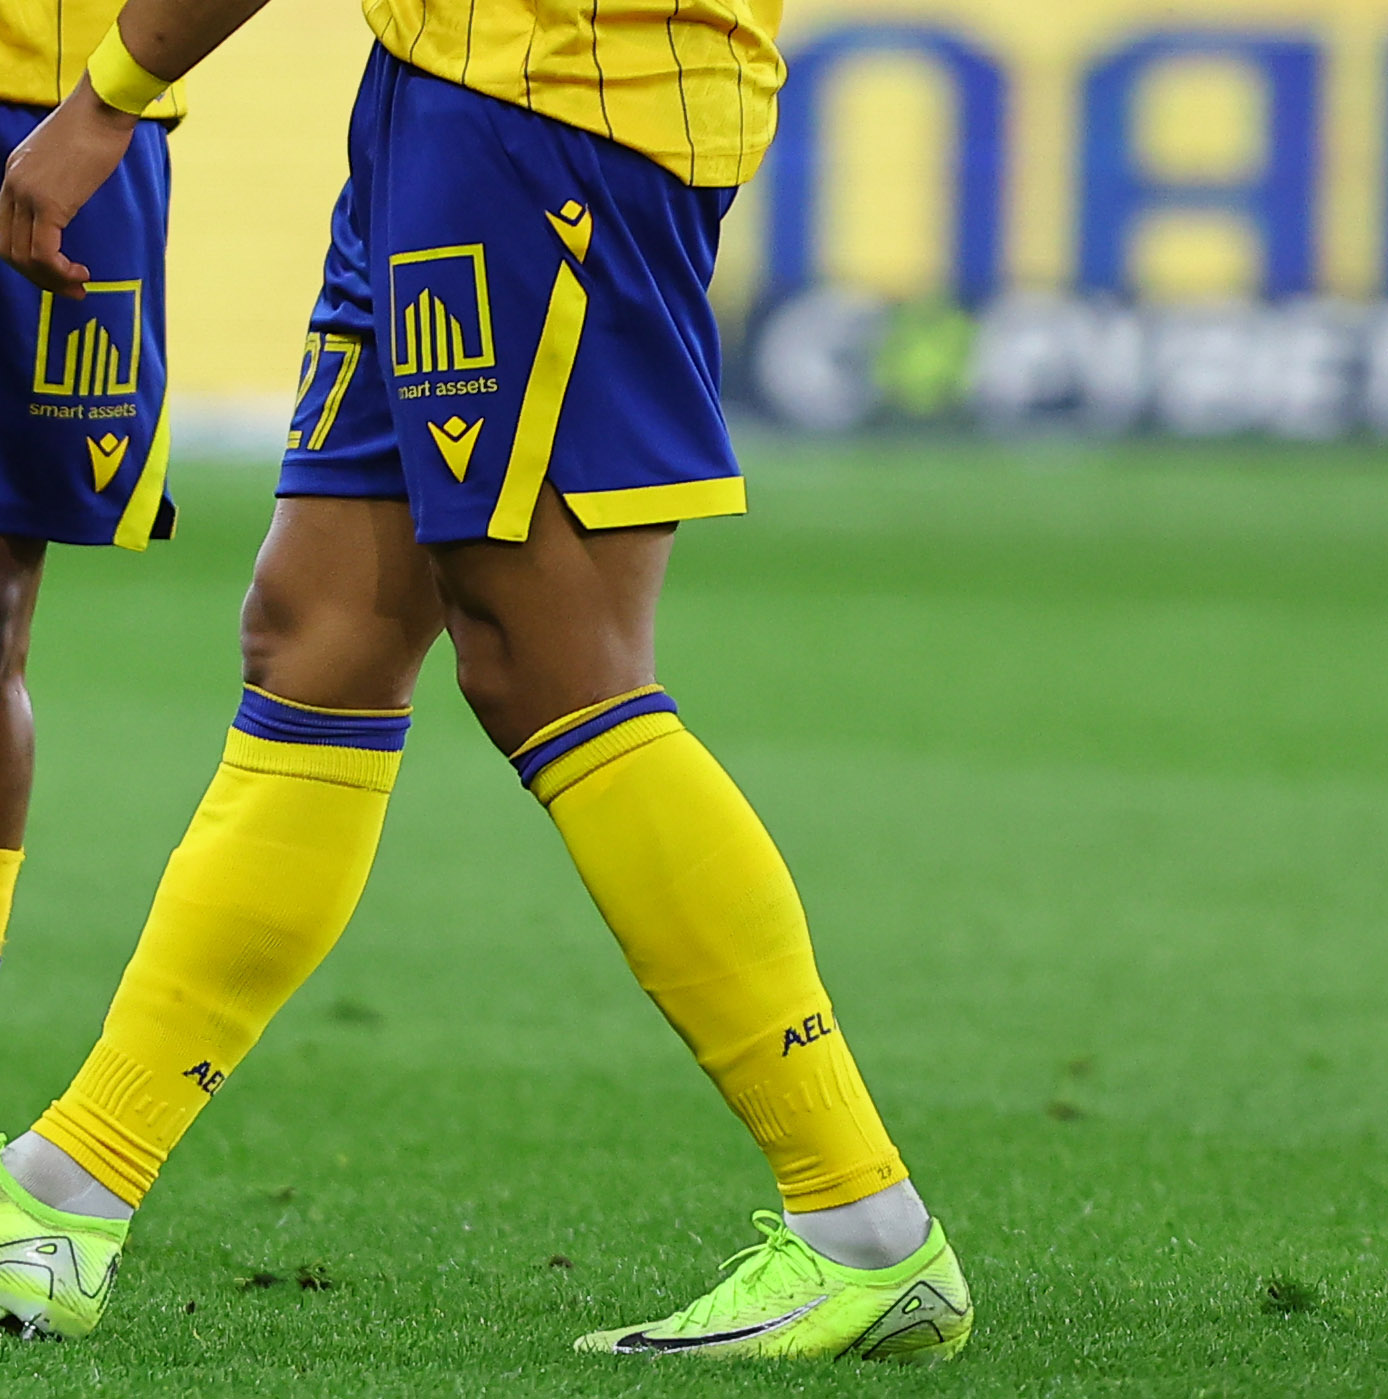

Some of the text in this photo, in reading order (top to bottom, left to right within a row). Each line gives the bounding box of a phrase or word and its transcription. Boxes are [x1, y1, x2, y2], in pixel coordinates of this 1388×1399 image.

[759, 18, 1388, 300] NA
[29, 402, 137, 420] smart assets
[286, 331, 363, 452] 27
[397, 376, 499, 400] mart assets
[781, 1011, 832, 1057] AEL
